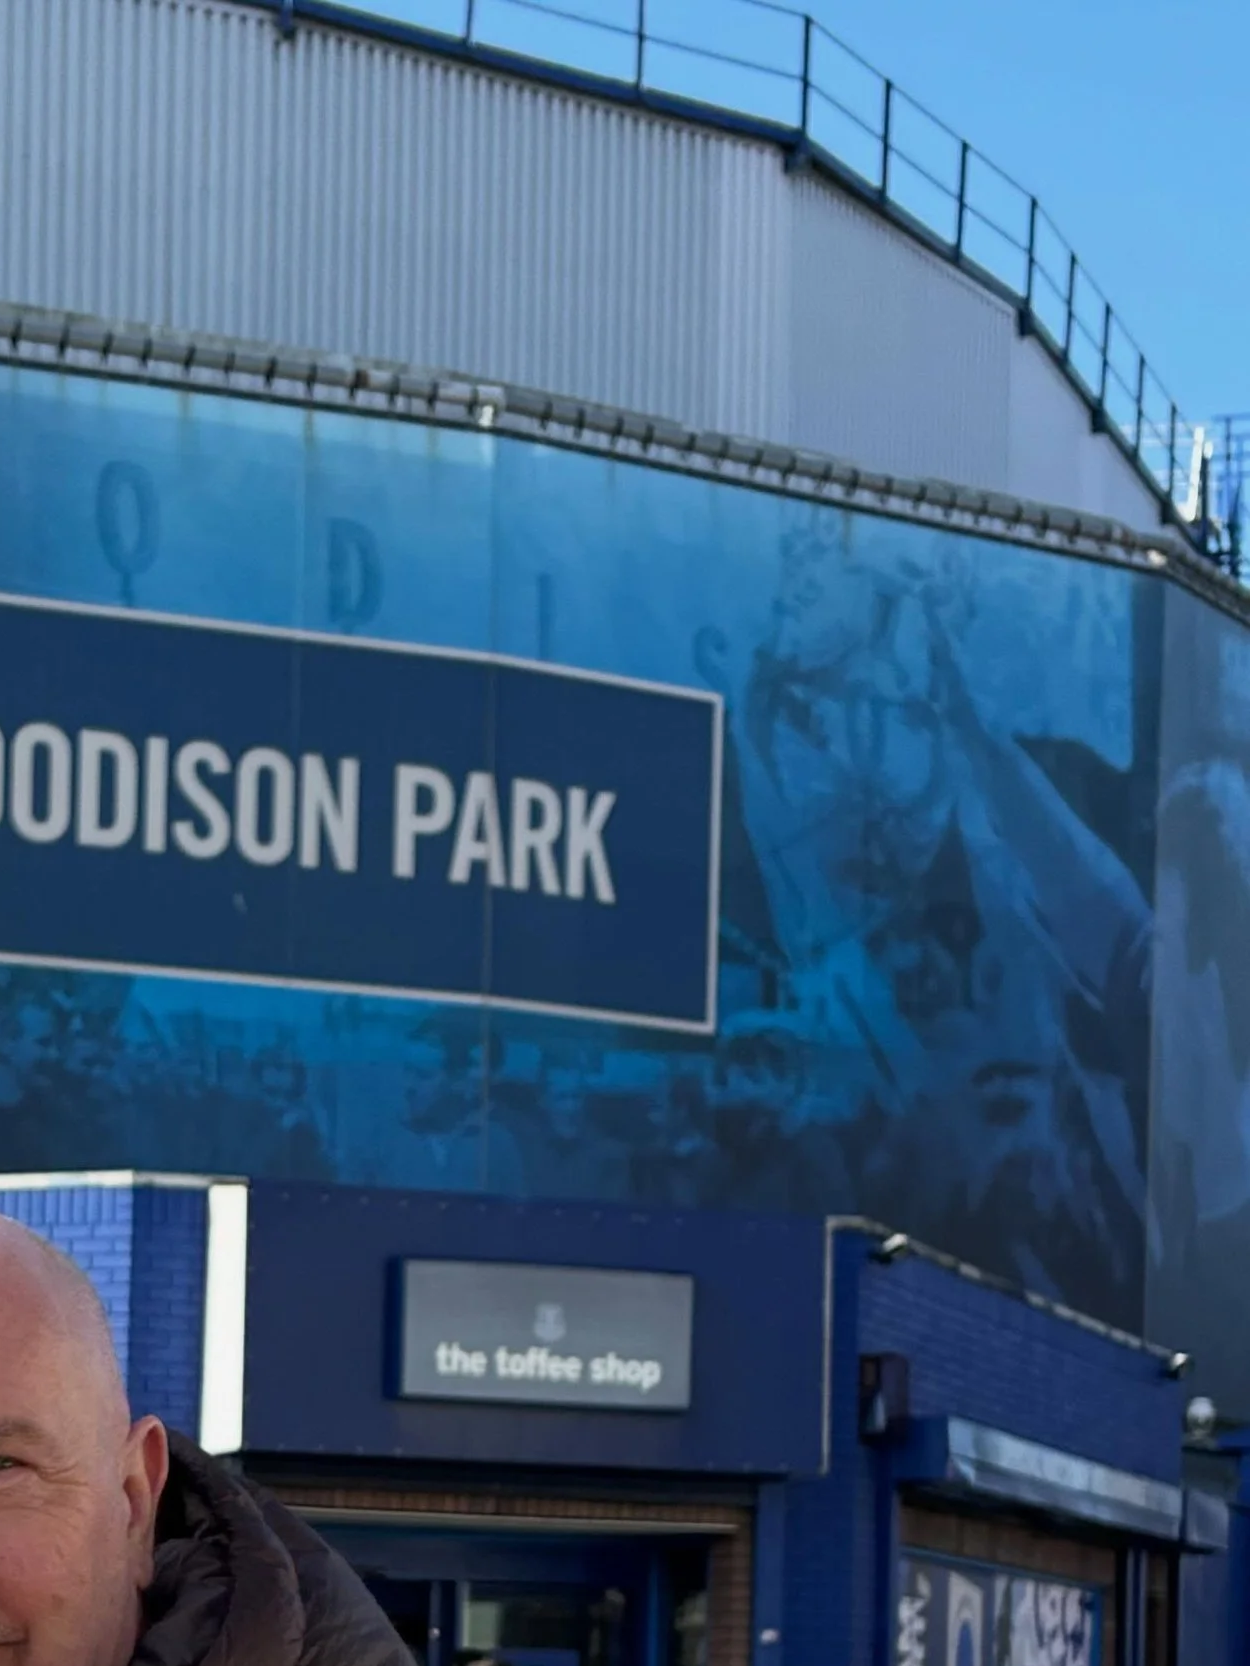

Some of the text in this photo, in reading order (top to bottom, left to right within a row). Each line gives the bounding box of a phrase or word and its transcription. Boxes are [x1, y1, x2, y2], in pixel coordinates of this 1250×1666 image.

[393, 763, 617, 903] PARK
[435, 1342, 662, 1393] the toffee shop
